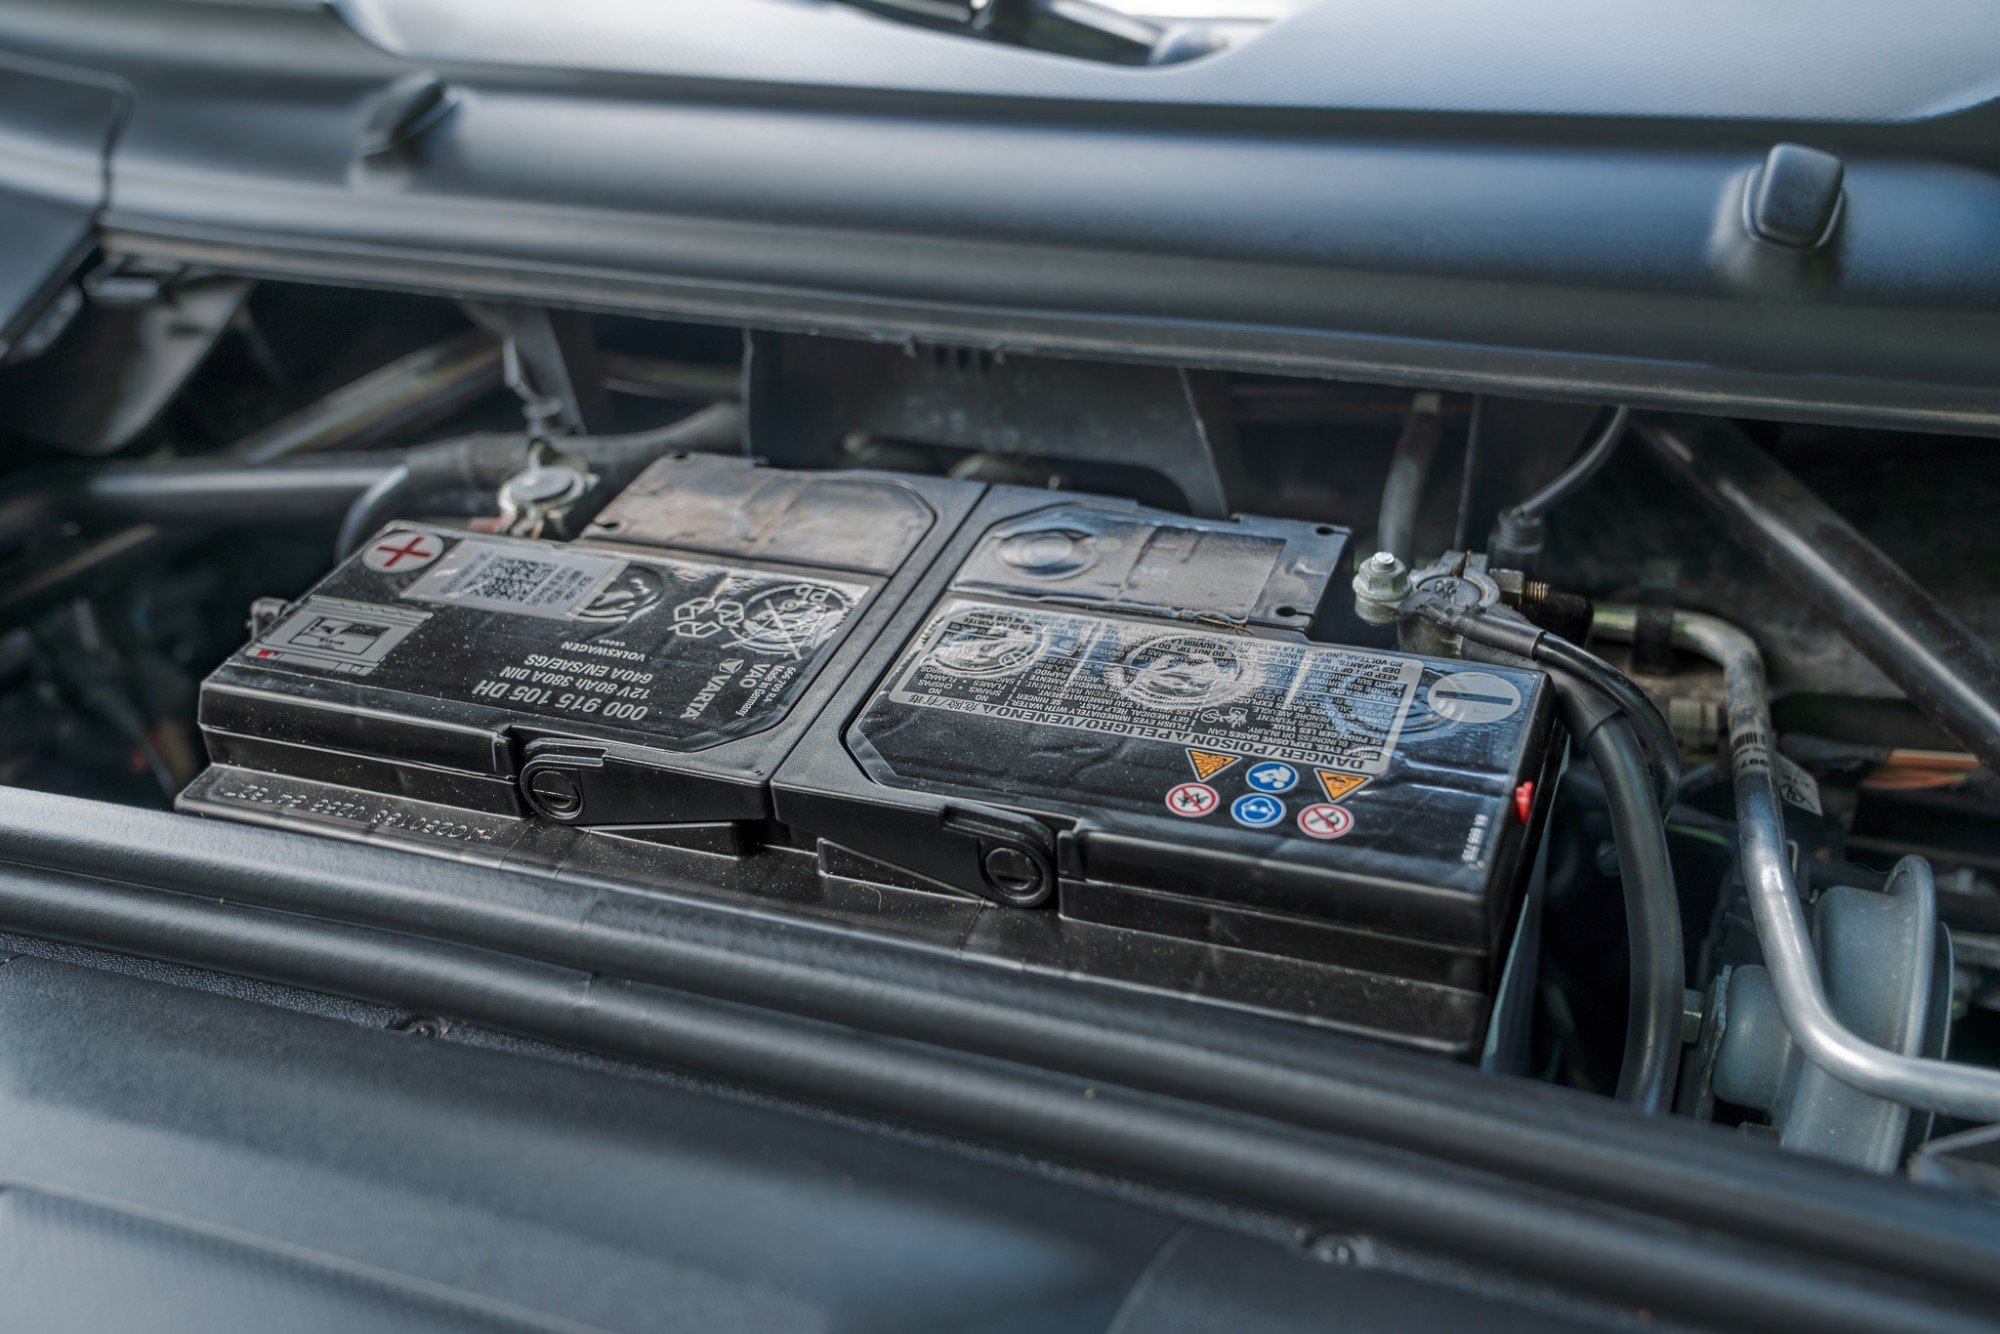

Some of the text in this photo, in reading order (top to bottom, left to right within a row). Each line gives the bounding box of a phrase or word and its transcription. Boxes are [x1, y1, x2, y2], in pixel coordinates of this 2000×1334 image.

[560, 641, 646, 662] VOLKSWAGEN
[523, 653, 653, 684] 640A EN/SAE/GS
[763, 664, 785, 682] Made
[739, 662, 771, 689] VAO
[922, 672, 1007, 690] FLAMES FLAMAS
[1068, 673, 1099, 683] ACUD
[499, 665, 651, 700] 12V 80Ah 380A DIN
[916, 679, 1002, 696] SPARKS CHISPAS
[471, 679, 649, 721] 000 915 105 DH
[679, 675, 731, 720] VARTA
[734, 688, 765, 716] Germany
[973, 693, 989, 701] NO
[1014, 693, 1050, 703] RINCER
[1043, 704, 1068, 713] WITH
[1068, 707, 1131, 721] IMMEDIATELY
[1103, 706, 1128, 715] HELP
[1128, 709, 1171, 721] MEDICAL
[1131, 716, 1156, 725] EYES
[1170, 715, 1190, 723] GET
[1156, 720, 1187, 729] FLUSH
[1206, 727, 1228, 736] CAN
[1228, 730, 1260, 740] GASES
[1280, 731, 1296, 739] OR
[1296, 727, 1317, 735] LES
[995, 706, 1365, 769] DANGER/POISON PELIGRO/VENENO
[1260, 735, 1313, 748] EXPLOSIVE
[1295, 734, 1348, 746] BLINDNESS
